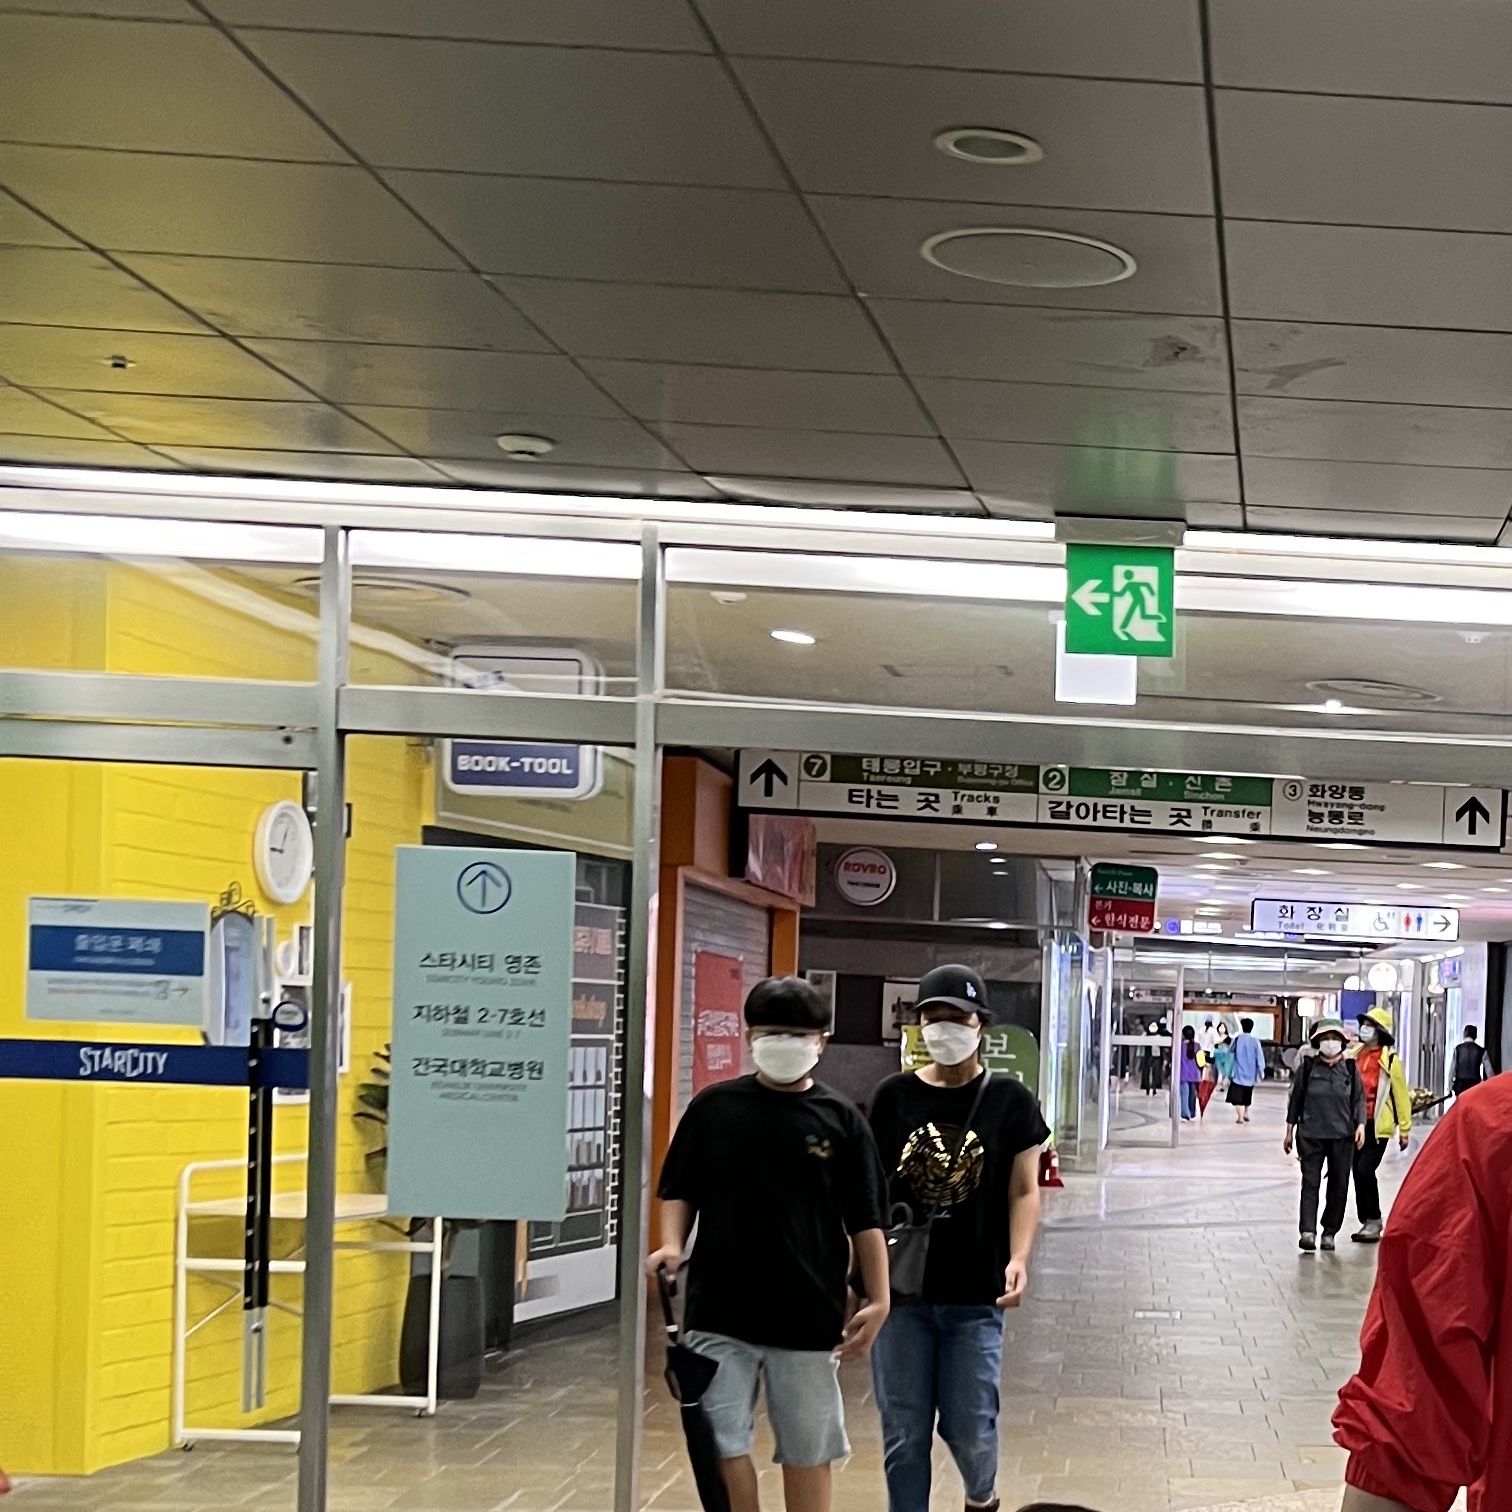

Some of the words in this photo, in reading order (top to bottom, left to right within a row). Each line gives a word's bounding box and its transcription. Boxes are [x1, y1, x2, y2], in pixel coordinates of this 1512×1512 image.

[457, 755, 573, 774] BOOK-TOOL
[1047, 770, 1062, 789] 2
[848, 788, 900, 809] 타는
[916, 792, 941, 812] 곳
[952, 791, 1001, 805] Tracks
[1308, 784, 1365, 800] 화양동
[1048, 800, 1152, 825] 갈아타는
[1168, 807, 1193, 828] 곳
[1202, 806, 1262, 820] Transfer
[1308, 809, 1365, 825] 능동로
[418, 952, 496, 972] 스타시티
[504, 954, 542, 975] 영존
[412, 1004, 470, 1024] 지하철
[79, 1047, 168, 1078] STARCITY
[412, 1057, 545, 1081] 건국대학교병원
